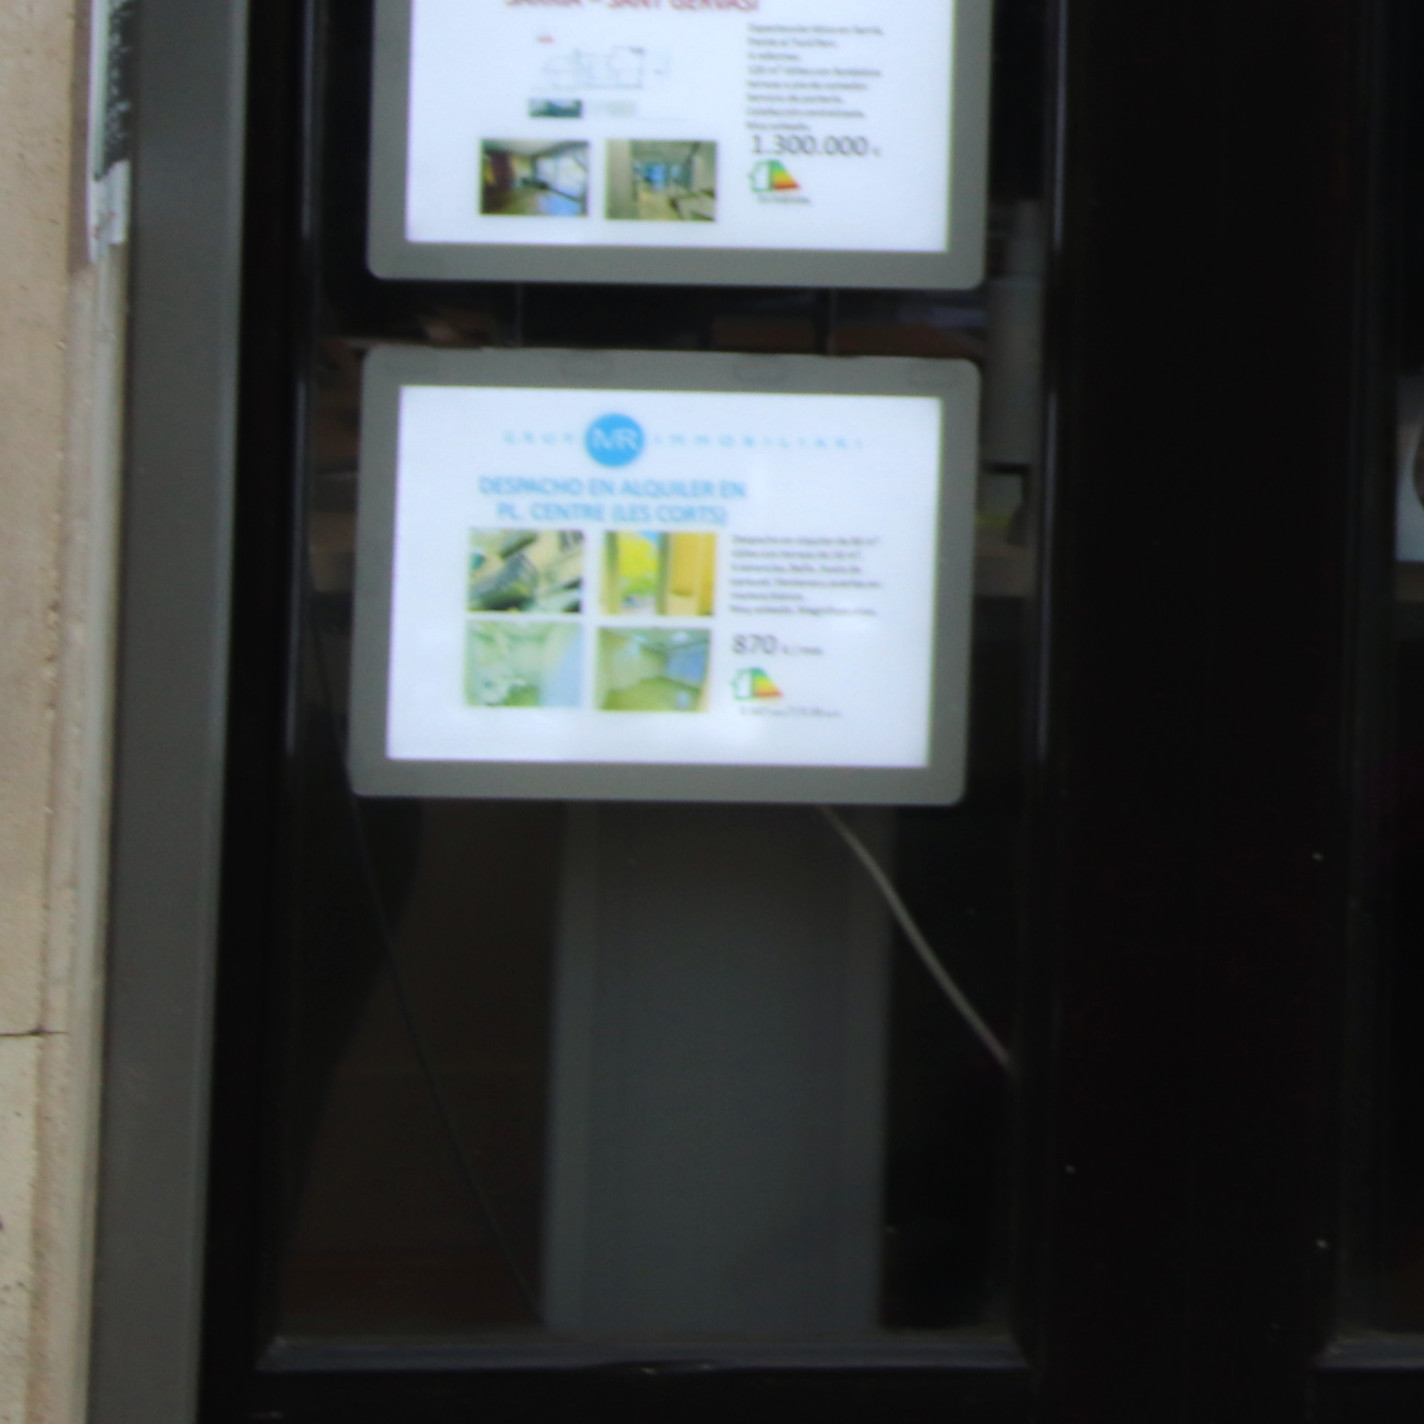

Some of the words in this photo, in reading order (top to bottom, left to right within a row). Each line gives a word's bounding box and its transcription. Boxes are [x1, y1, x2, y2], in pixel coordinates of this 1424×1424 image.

[752, 135, 870, 157] 1.300.000
[477, 476, 584, 497] DESPACHO
[589, 478, 616, 497] EN
[621, 480, 714, 502] ALQUILER
[720, 481, 747, 500] EN
[530, 504, 605, 523] CENTRE
[655, 506, 728, 527] CORTS)
[731, 634, 778, 656] 870
